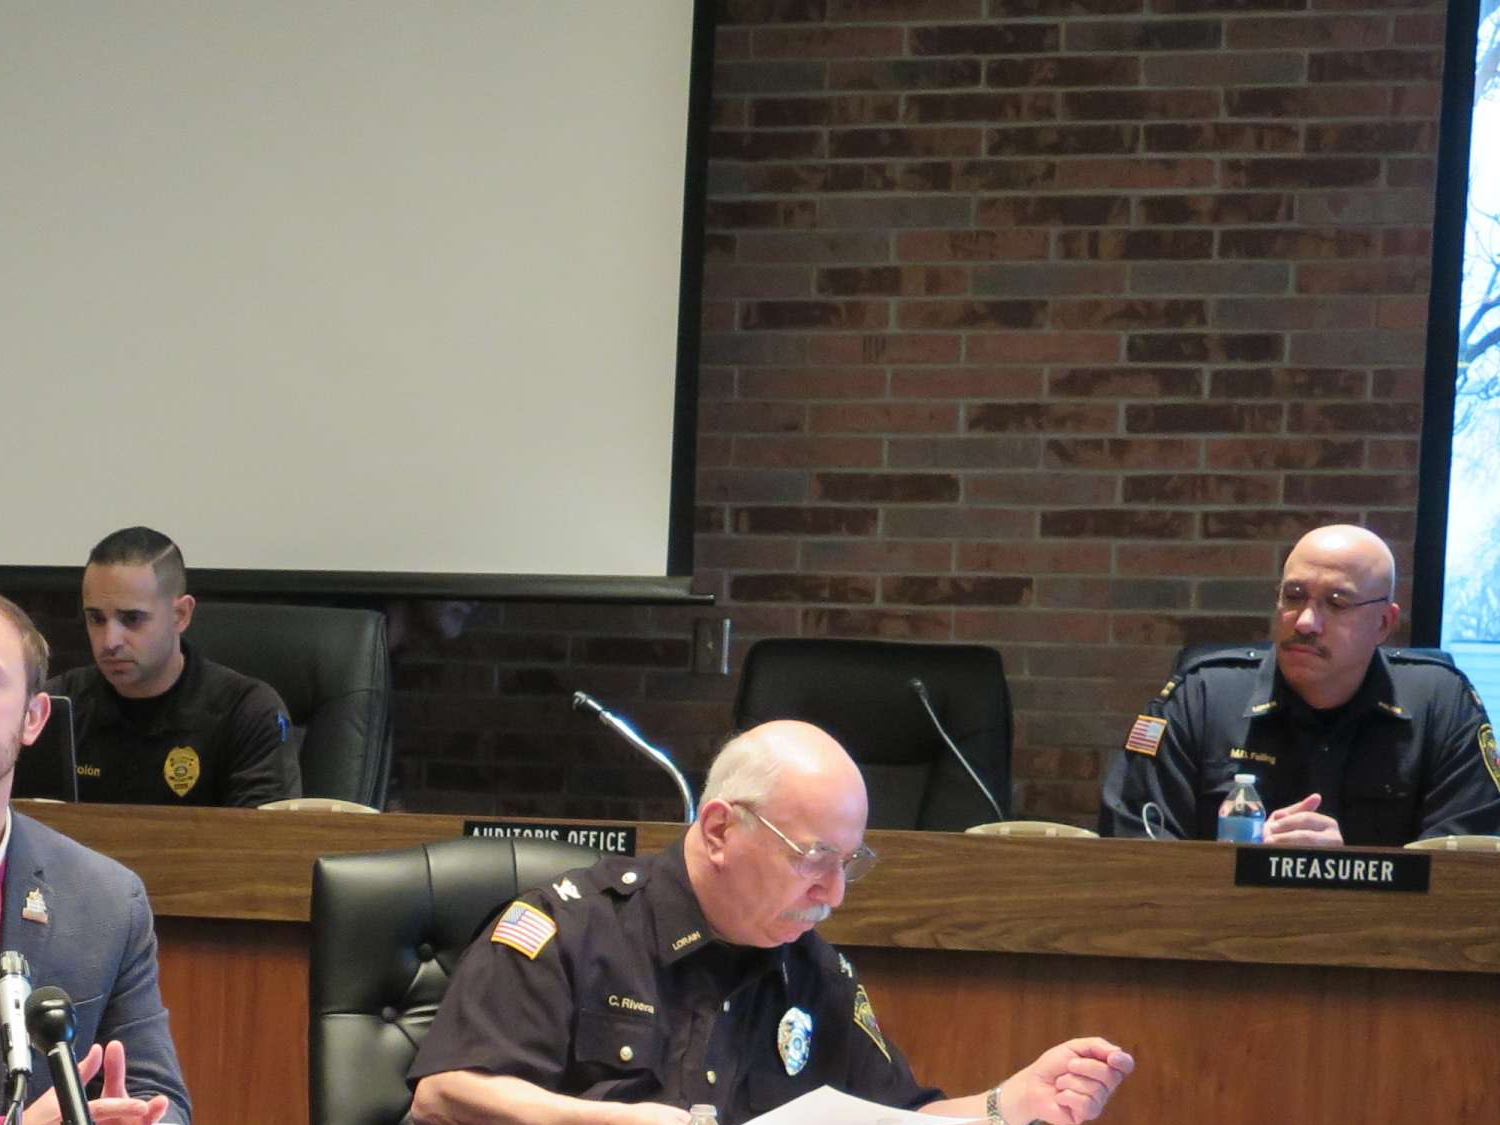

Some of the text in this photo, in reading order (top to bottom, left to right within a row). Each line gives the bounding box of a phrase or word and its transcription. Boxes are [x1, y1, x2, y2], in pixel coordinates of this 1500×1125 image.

[76, 764, 100, 776] olón
[567, 830, 627, 852] OFFICE
[1269, 856, 1394, 882] TREASURER
[621, 997, 655, 1014] Rivera
